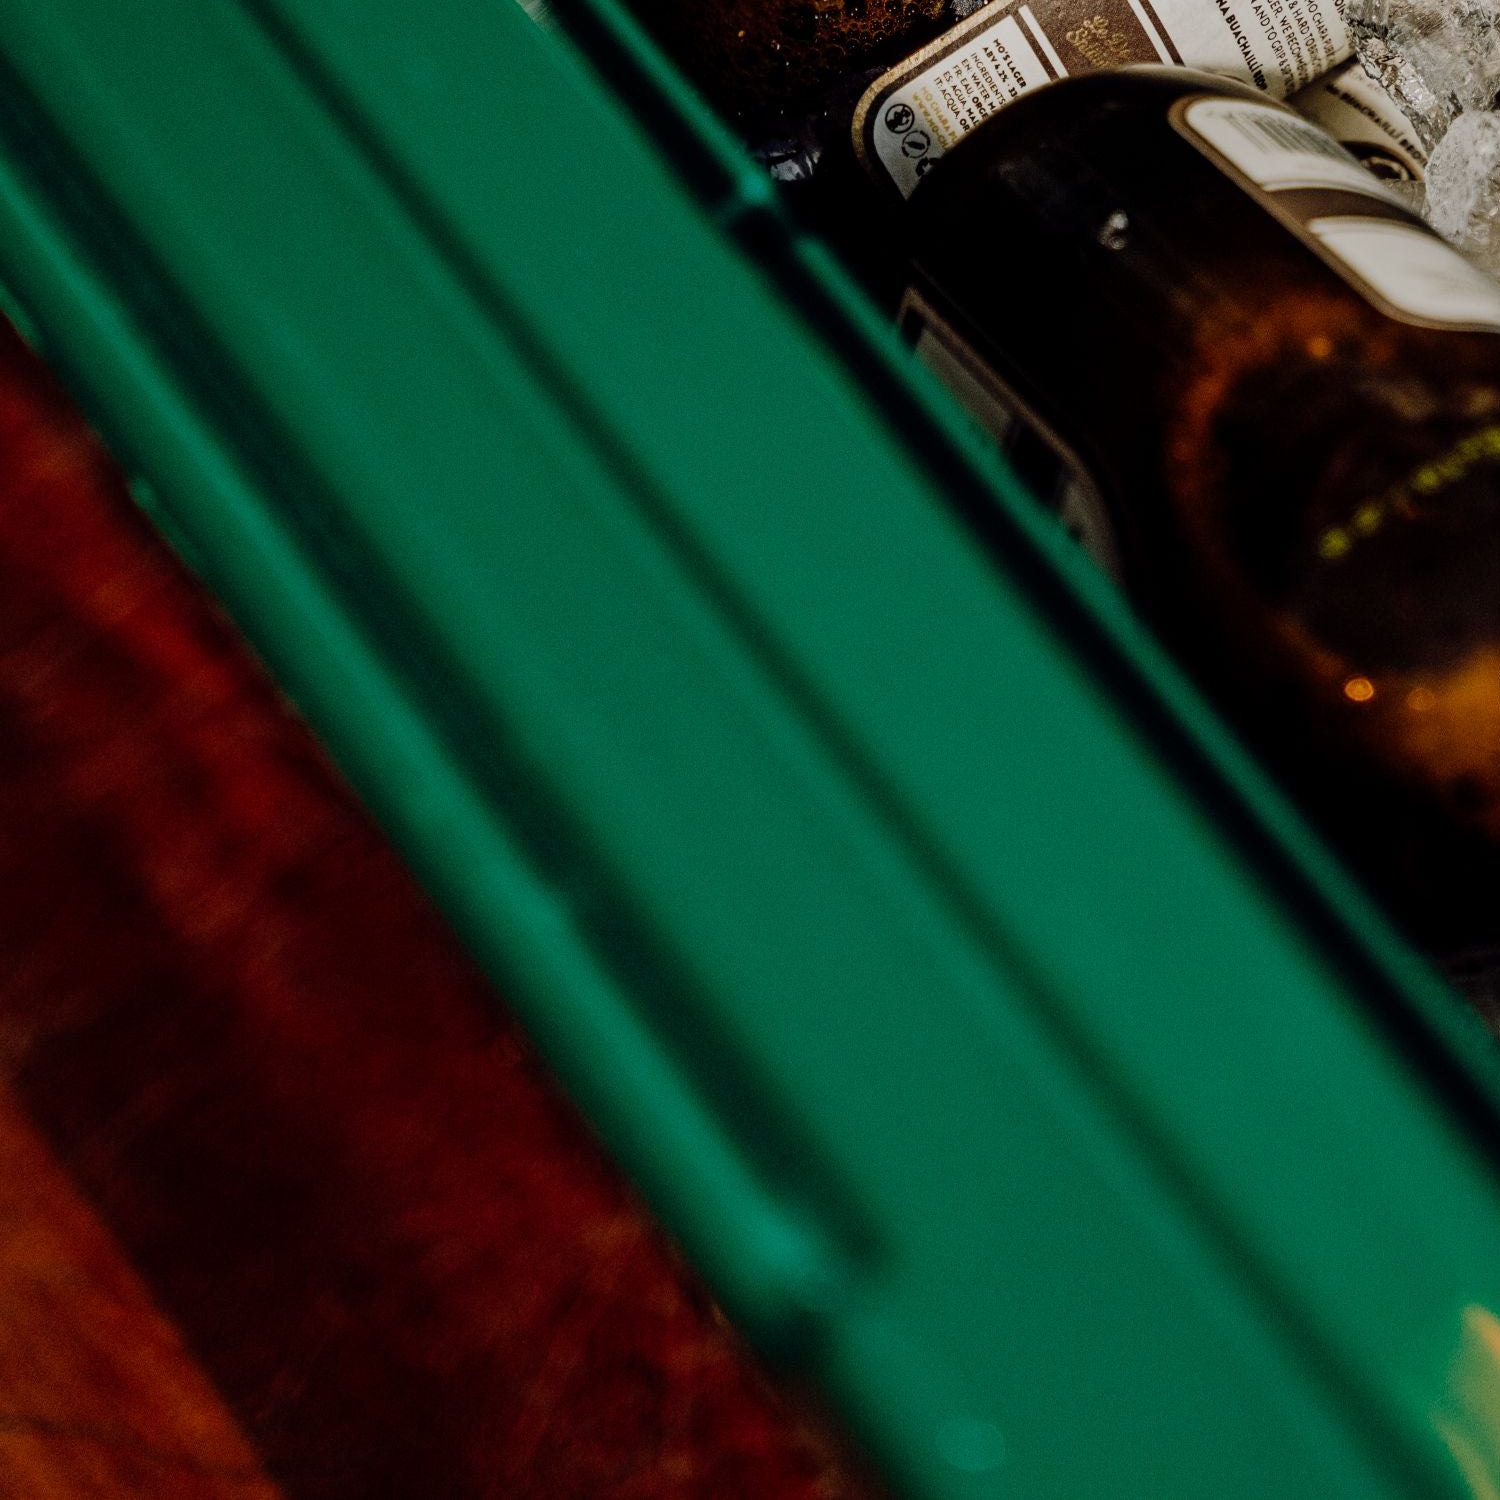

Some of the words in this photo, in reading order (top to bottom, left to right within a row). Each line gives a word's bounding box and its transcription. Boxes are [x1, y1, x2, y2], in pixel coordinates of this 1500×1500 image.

[1252, 3, 1270, 27] AND
[1287, 0, 1298, 10] &
[1263, 25, 1277, 42] TO
[1277, 15, 1292, 34] WE
[1291, 8, 1310, 36] HARD
[1310, 11, 1330, 40] CHARA
[1223, 13, 1263, 73] BUACHAILLÍ
[1269, 39, 1286, 60] GRIP
[1303, 33, 1316, 48] TO
[982, 45, 996, 63] ABV
[993, 63, 1008, 82] 4.2%
[993, 38, 1009, 60] MO'S
[1007, 61, 1026, 87] LAGER
[1278, 58, 1288, 66] &
[920, 86, 932, 101] MO
[929, 101, 951, 131] CHARA
[940, 88, 962, 119] ACQUA,
[959, 118, 972, 134] OR
[965, 108, 979, 126] MAL
